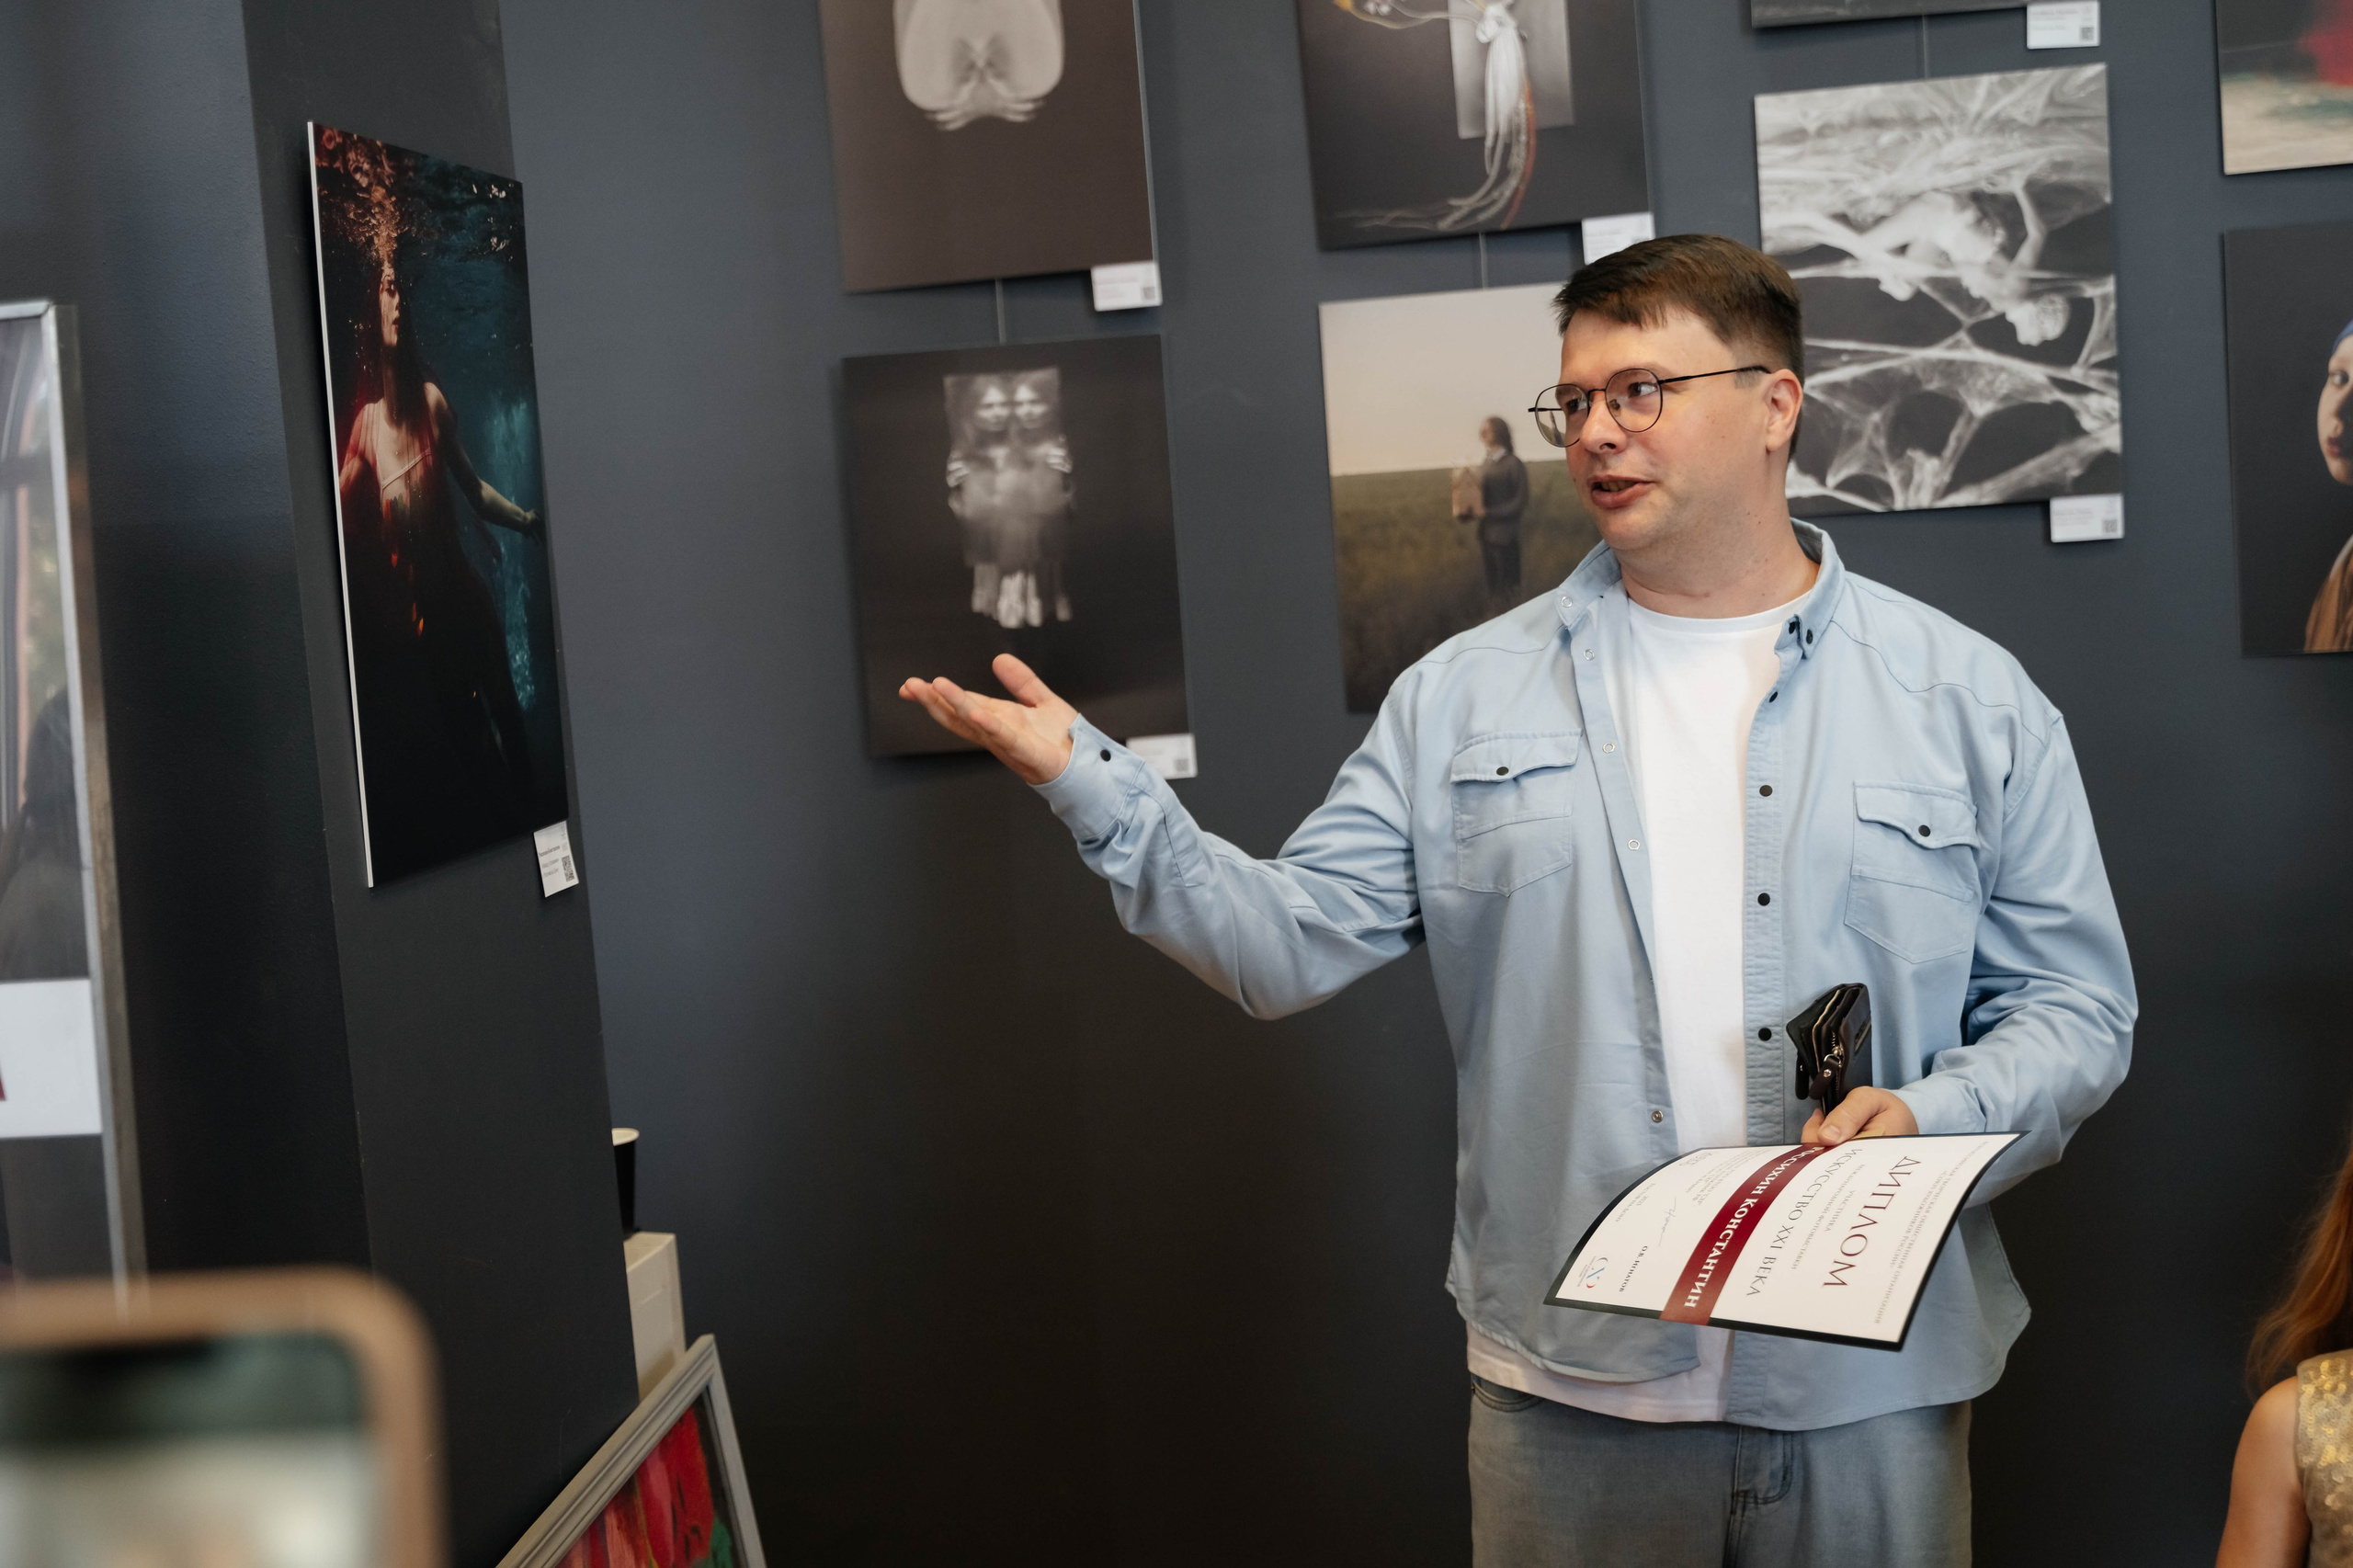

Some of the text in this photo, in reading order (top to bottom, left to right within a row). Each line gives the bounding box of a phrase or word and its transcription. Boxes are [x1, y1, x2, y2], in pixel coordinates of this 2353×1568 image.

[1746, 1148, 1863, 1296] ИСКУССТВО XXI ВЕКА
[1822, 1155, 1921, 1287] ДИПЛОМ
[1824, 1189, 1856, 1232] УЧАСТНИКА
